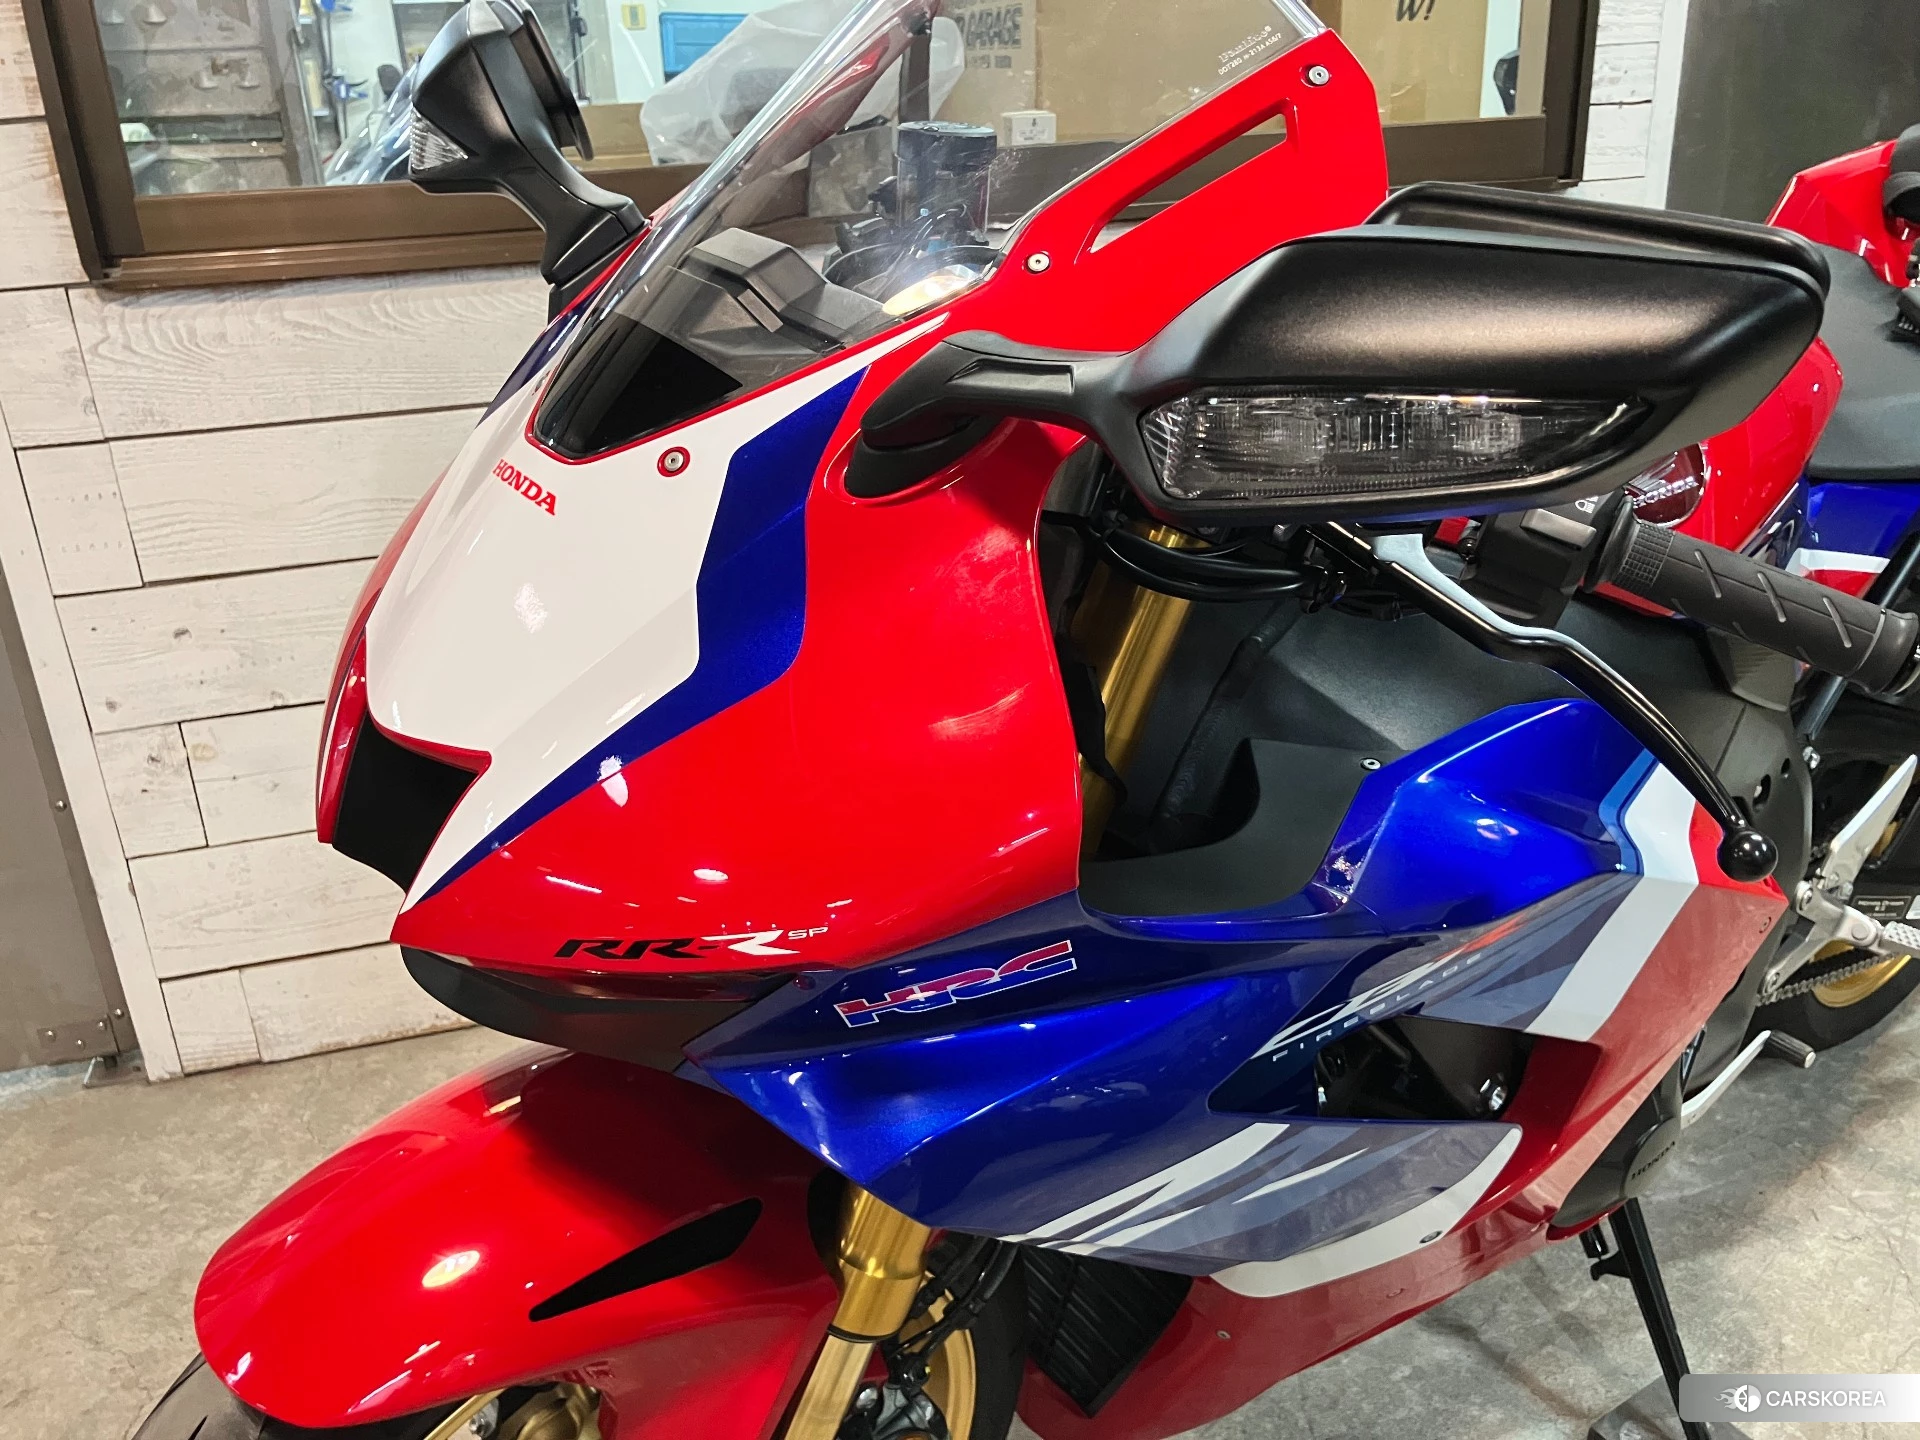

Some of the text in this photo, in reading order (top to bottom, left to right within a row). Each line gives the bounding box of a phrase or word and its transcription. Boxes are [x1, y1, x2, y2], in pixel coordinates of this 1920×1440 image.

[492, 458, 557, 516] HONDA
[787, 926, 829, 941] SP
[833, 939, 1078, 1029] HRC
[1272, 952, 1482, 1063] FIREBLADE
